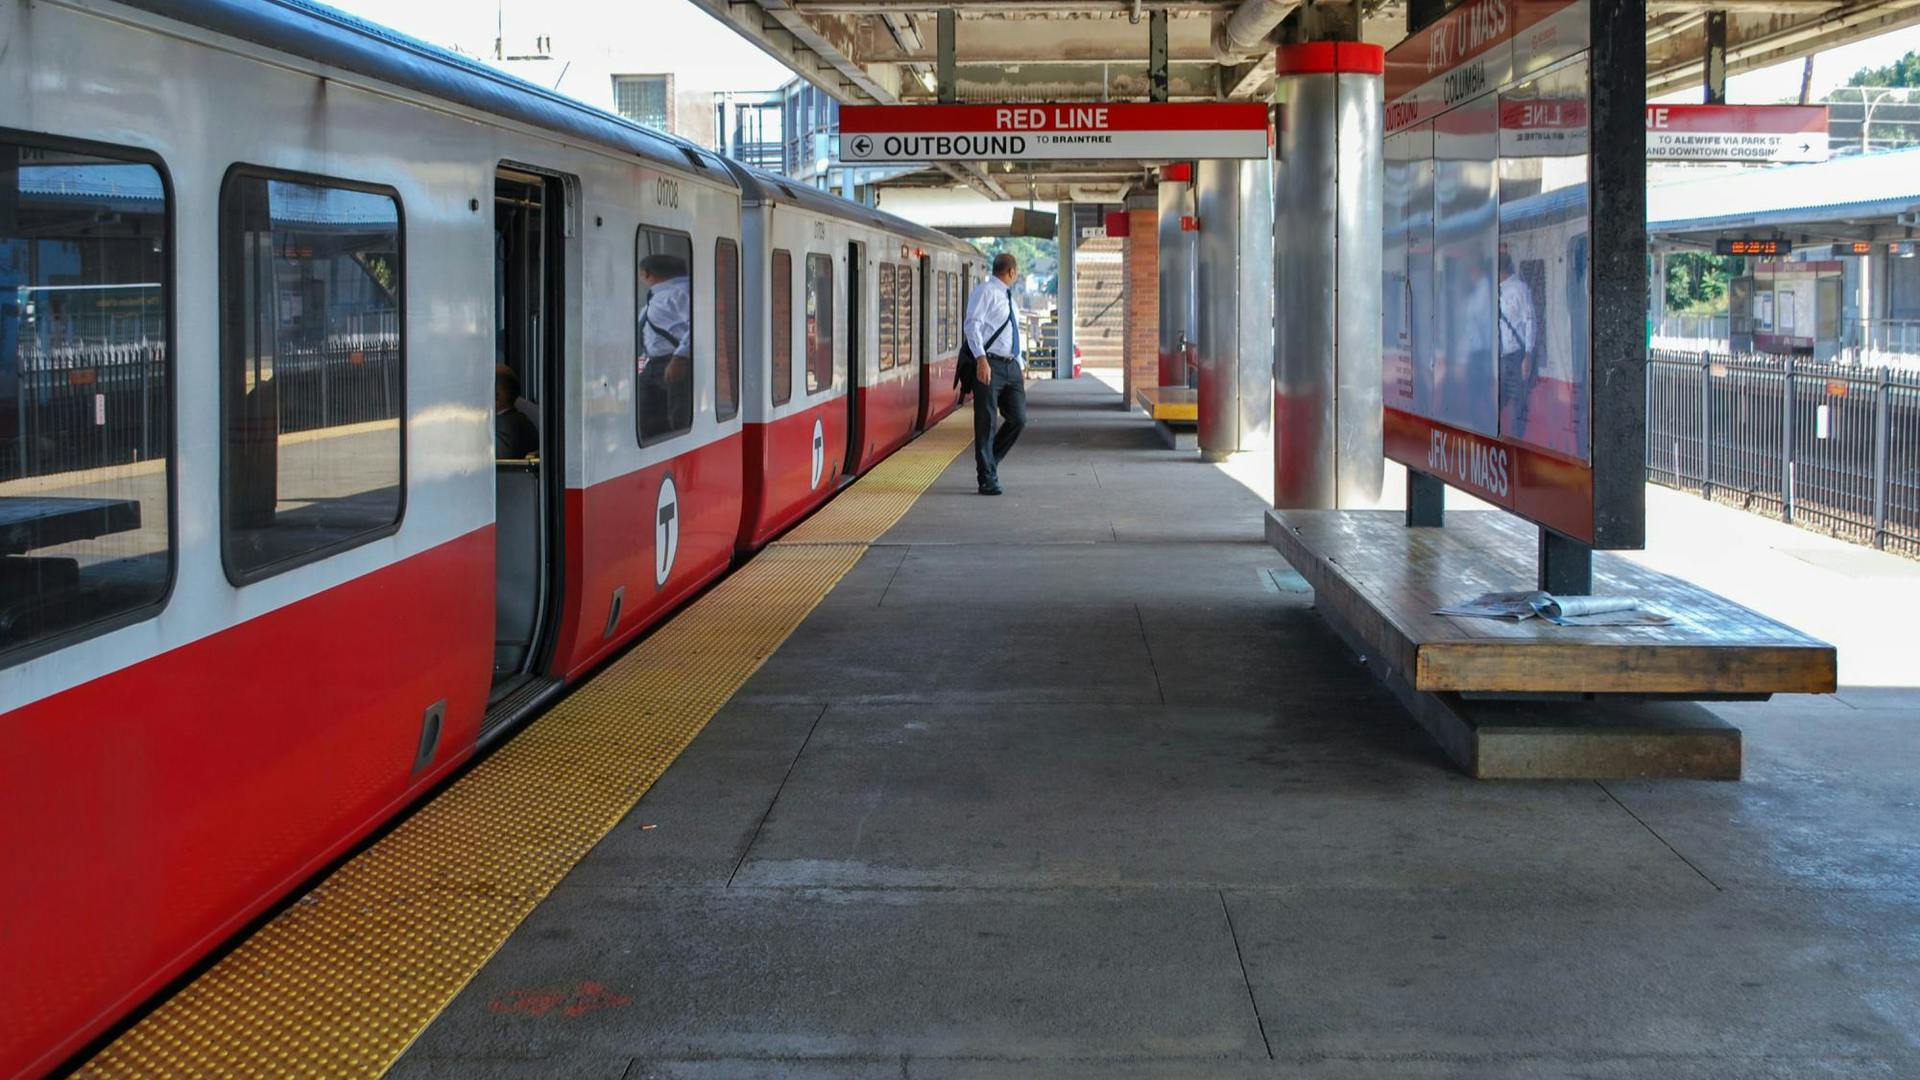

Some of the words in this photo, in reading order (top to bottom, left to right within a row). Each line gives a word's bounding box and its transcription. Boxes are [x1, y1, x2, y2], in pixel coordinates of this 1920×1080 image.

[1426, 24, 1448, 74] JFK
[1458, 12, 1467, 57] U
[1470, 0, 1507, 49] MASS
[1444, 60, 1485, 106] COLUMBIA
[996, 108, 1046, 130] RED
[1055, 108, 1110, 129] LINE
[1386, 95, 1418, 132] OUTBOUND
[884, 135, 1027, 157] OUTBOUND
[1036, 136, 1050, 145] TO
[1052, 135, 1113, 145] BRAINTREE
[1646, 147, 1666, 156] AND
[1669, 147, 1728, 156] DOWNTOWN
[1731, 147, 1778, 156] CROSSIN
[1659, 136, 1672, 145] TO
[1674, 136, 1721, 145] ALEWIFE
[1723, 136, 1739, 145] VIA
[1741, 136, 1766, 145] PARK
[656, 175, 679, 209] 01708
[1427, 428, 1448, 473] JFK
[1458, 437, 1467, 481] U
[1471, 441, 1509, 497] MASS
